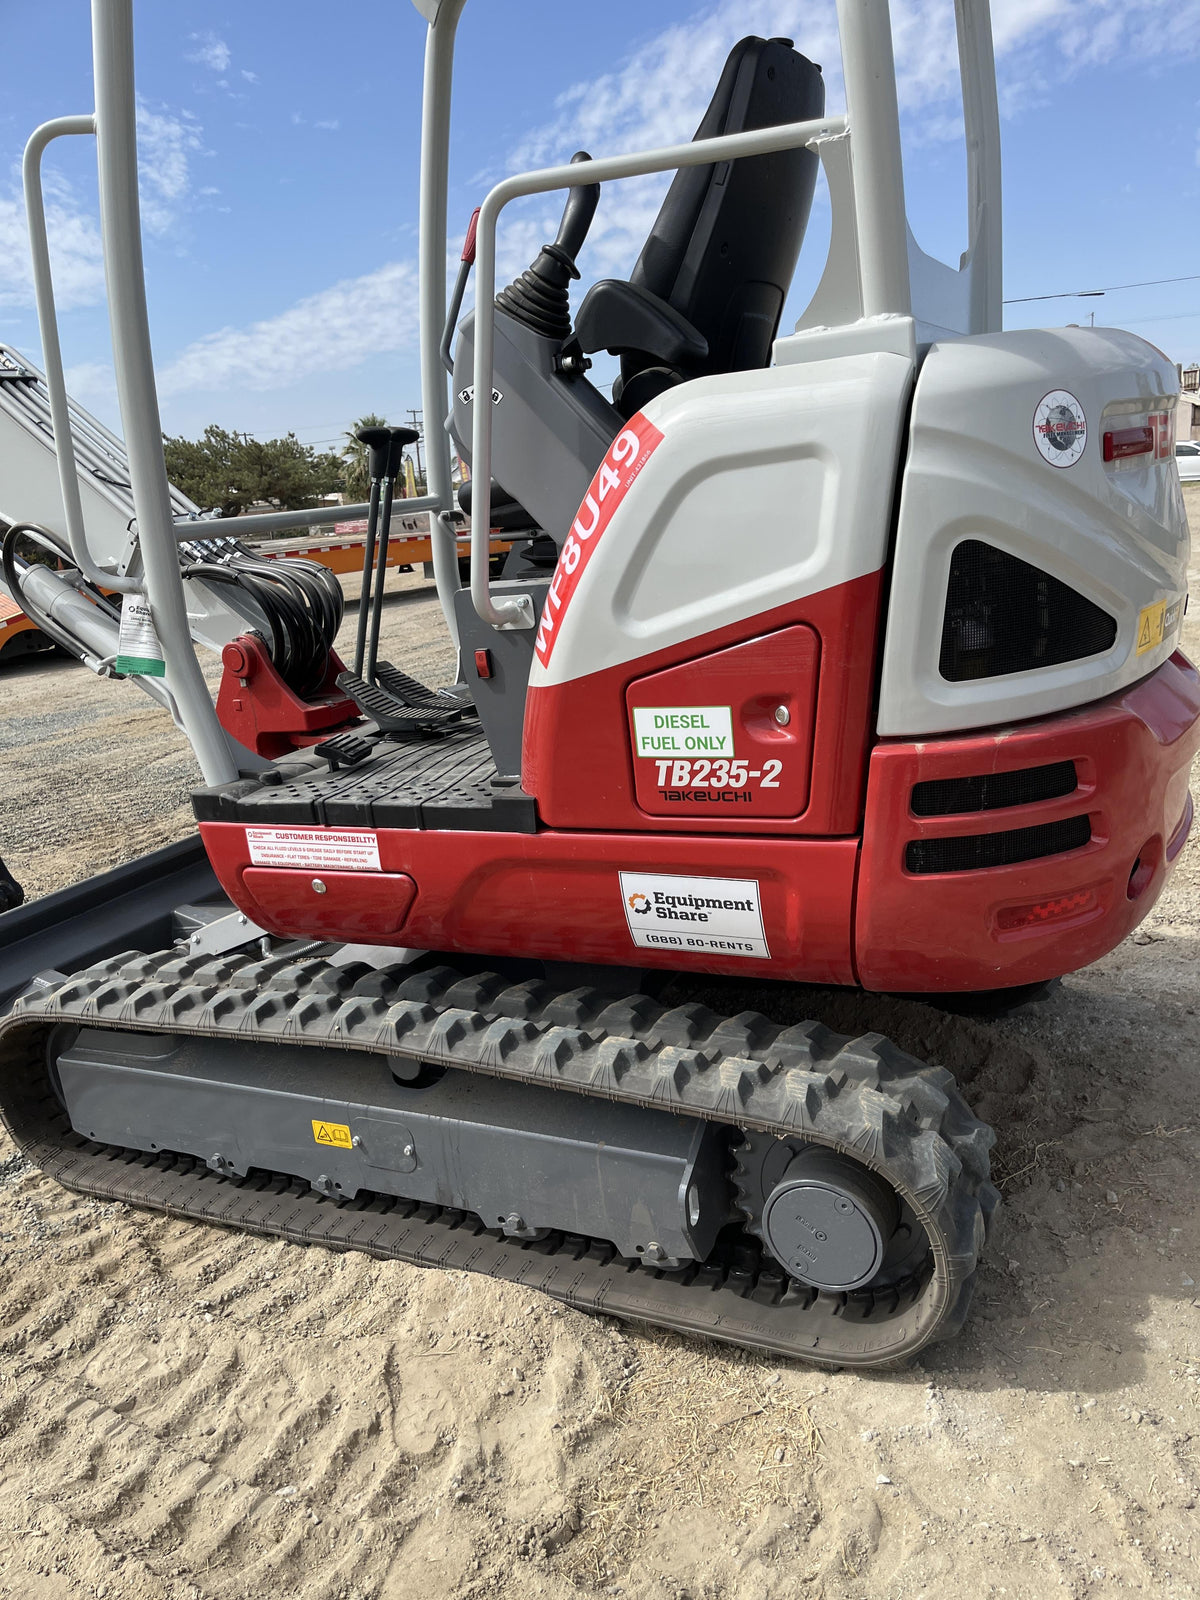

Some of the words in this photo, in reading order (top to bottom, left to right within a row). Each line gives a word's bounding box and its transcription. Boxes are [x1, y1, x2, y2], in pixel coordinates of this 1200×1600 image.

[535, 429, 641, 653] WF8U49
[654, 714, 710, 729] DIESEL
[641, 736, 680, 750] FUEL
[684, 736, 727, 750] ONLY
[654, 759, 783, 788] TB235-2
[658, 790, 752, 802] TAKEUCHI
[275, 832, 314, 841] CUSTOMER
[315, 834, 376, 844] RESPONSIBILITY
[653, 891, 754, 912] Equipment
[645, 934, 683, 945] (888)
[686, 938, 754, 951] 80-RENTS
